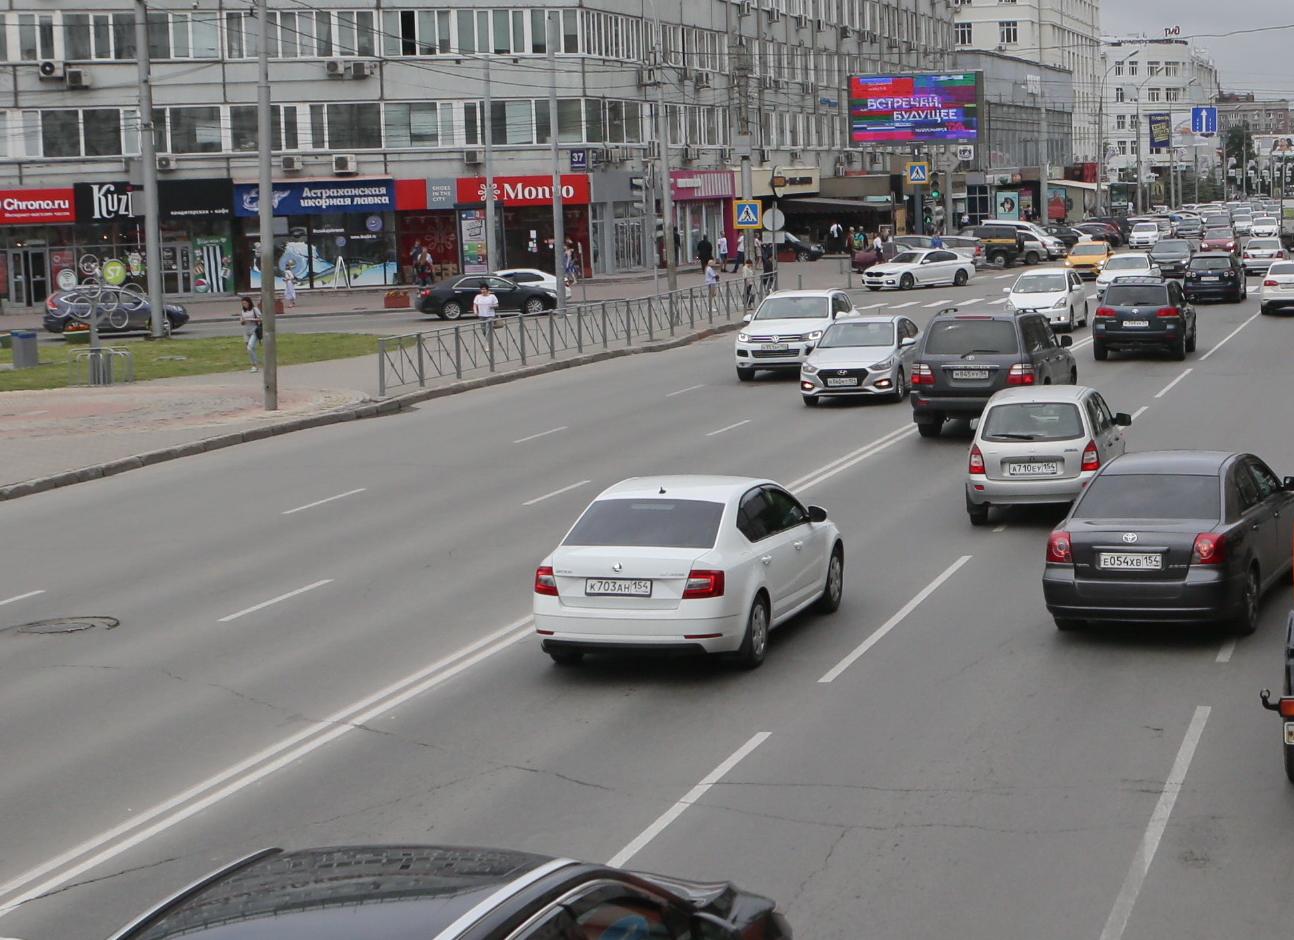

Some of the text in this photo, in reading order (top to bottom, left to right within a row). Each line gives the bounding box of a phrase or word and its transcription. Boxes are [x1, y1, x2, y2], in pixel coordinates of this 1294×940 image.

[867, 94, 941, 110] ВСТРЕЧАЙ,
[893, 109, 957, 122] БУДУЩЕЕ
[572, 152, 584, 162] 37
[302, 187, 387, 198] Астраханская
[503, 183, 574, 200] Mono
[3, 198, 69, 210] Chrono.ru
[300, 196, 390, 208] икорная лавка
[1103, 556, 1160, 567] Е054ХВ 154
[590, 580, 648, 593] К703АН 154
